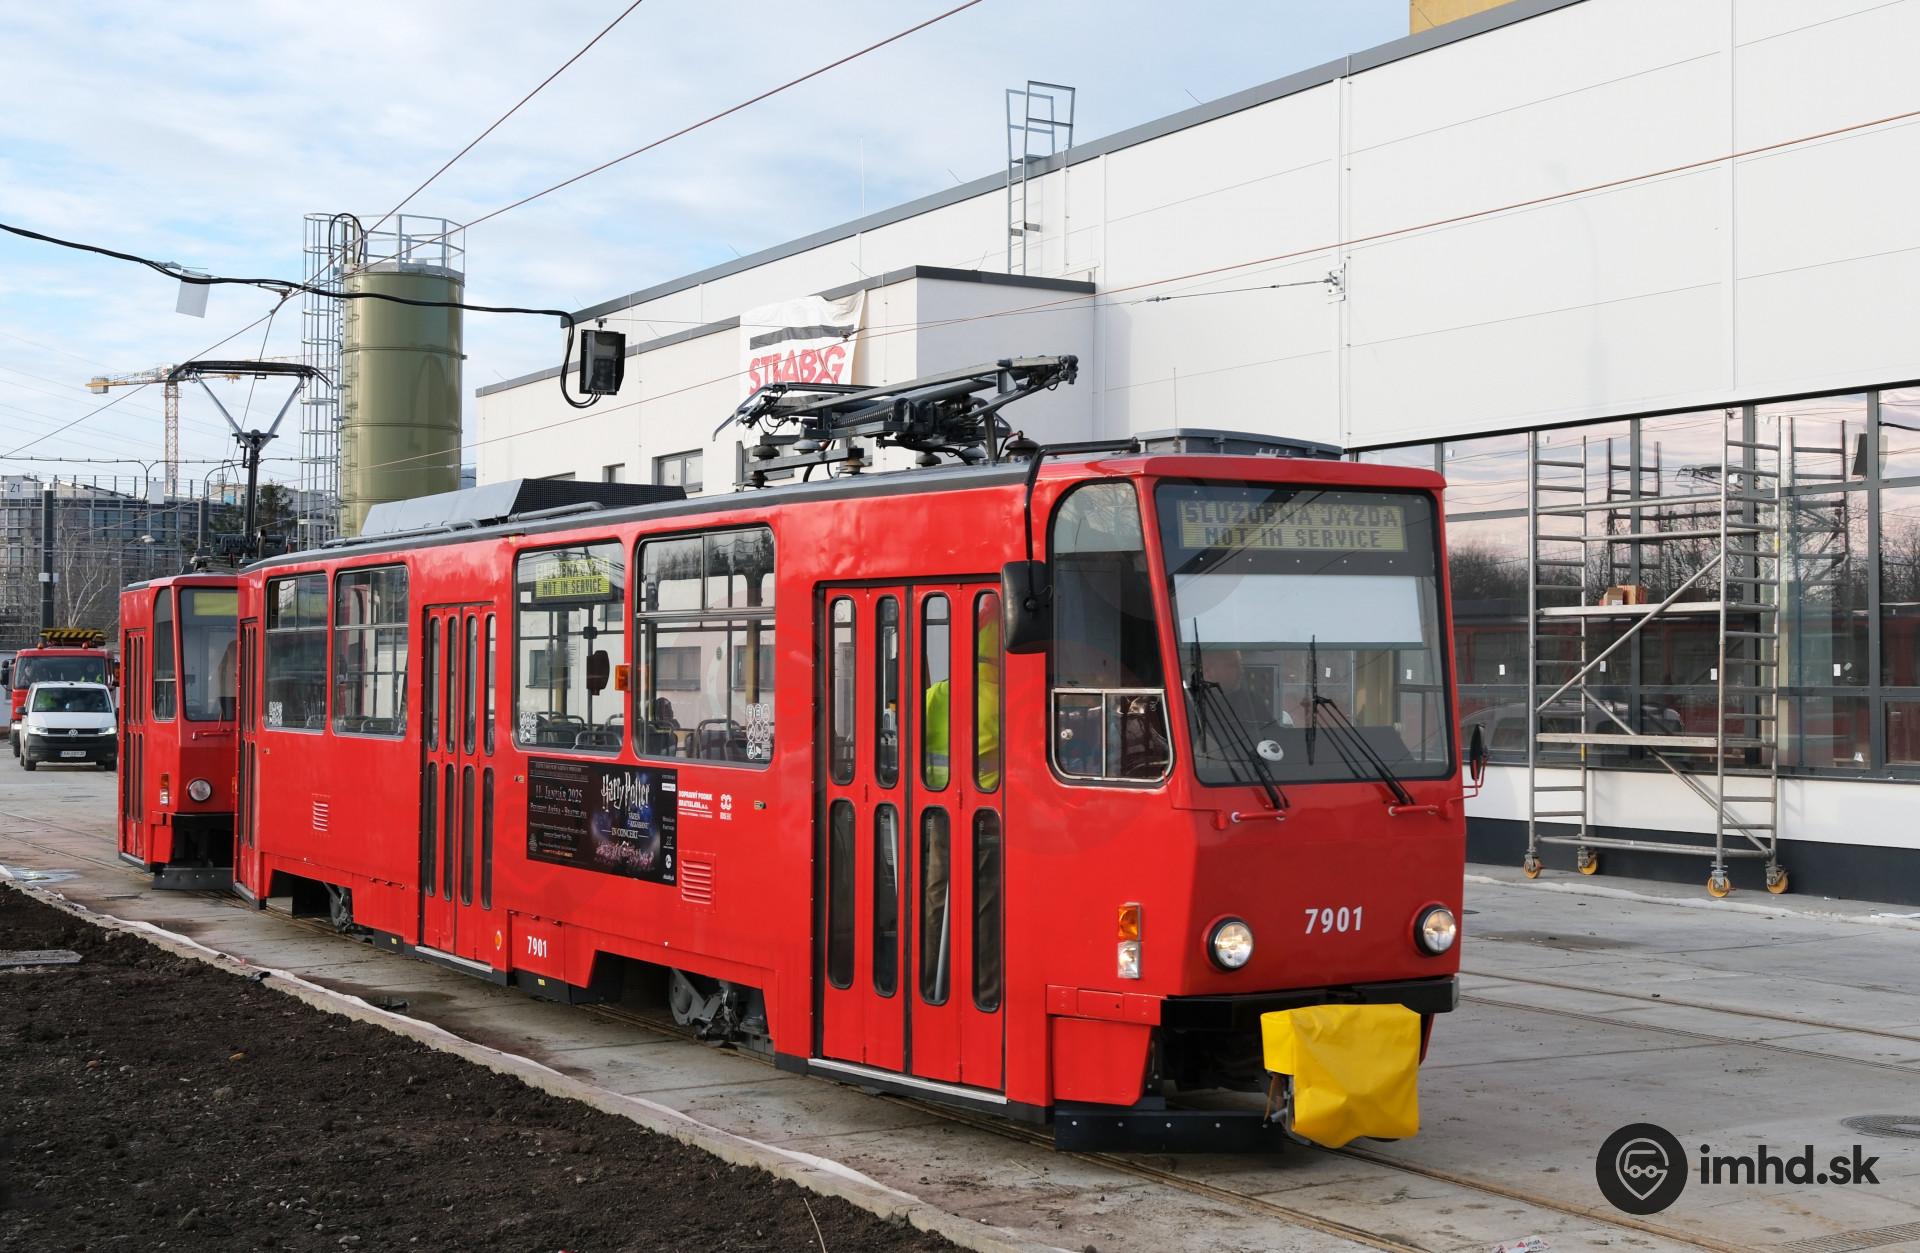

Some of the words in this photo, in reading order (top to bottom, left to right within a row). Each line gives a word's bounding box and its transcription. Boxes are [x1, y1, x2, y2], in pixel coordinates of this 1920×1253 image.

[1321, 503, 1399, 527] JAZDA
[1205, 528, 1249, 547] NOT
[1261, 528, 1284, 548] IN
[1296, 529, 1383, 549] SERVICE
[571, 578, 602, 594] SERVICE
[601, 773, 624, 812] Harry
[624, 771, 650, 811] Potter
[1304, 905, 1363, 935] 7901
[527, 935, 547, 958] 7901
